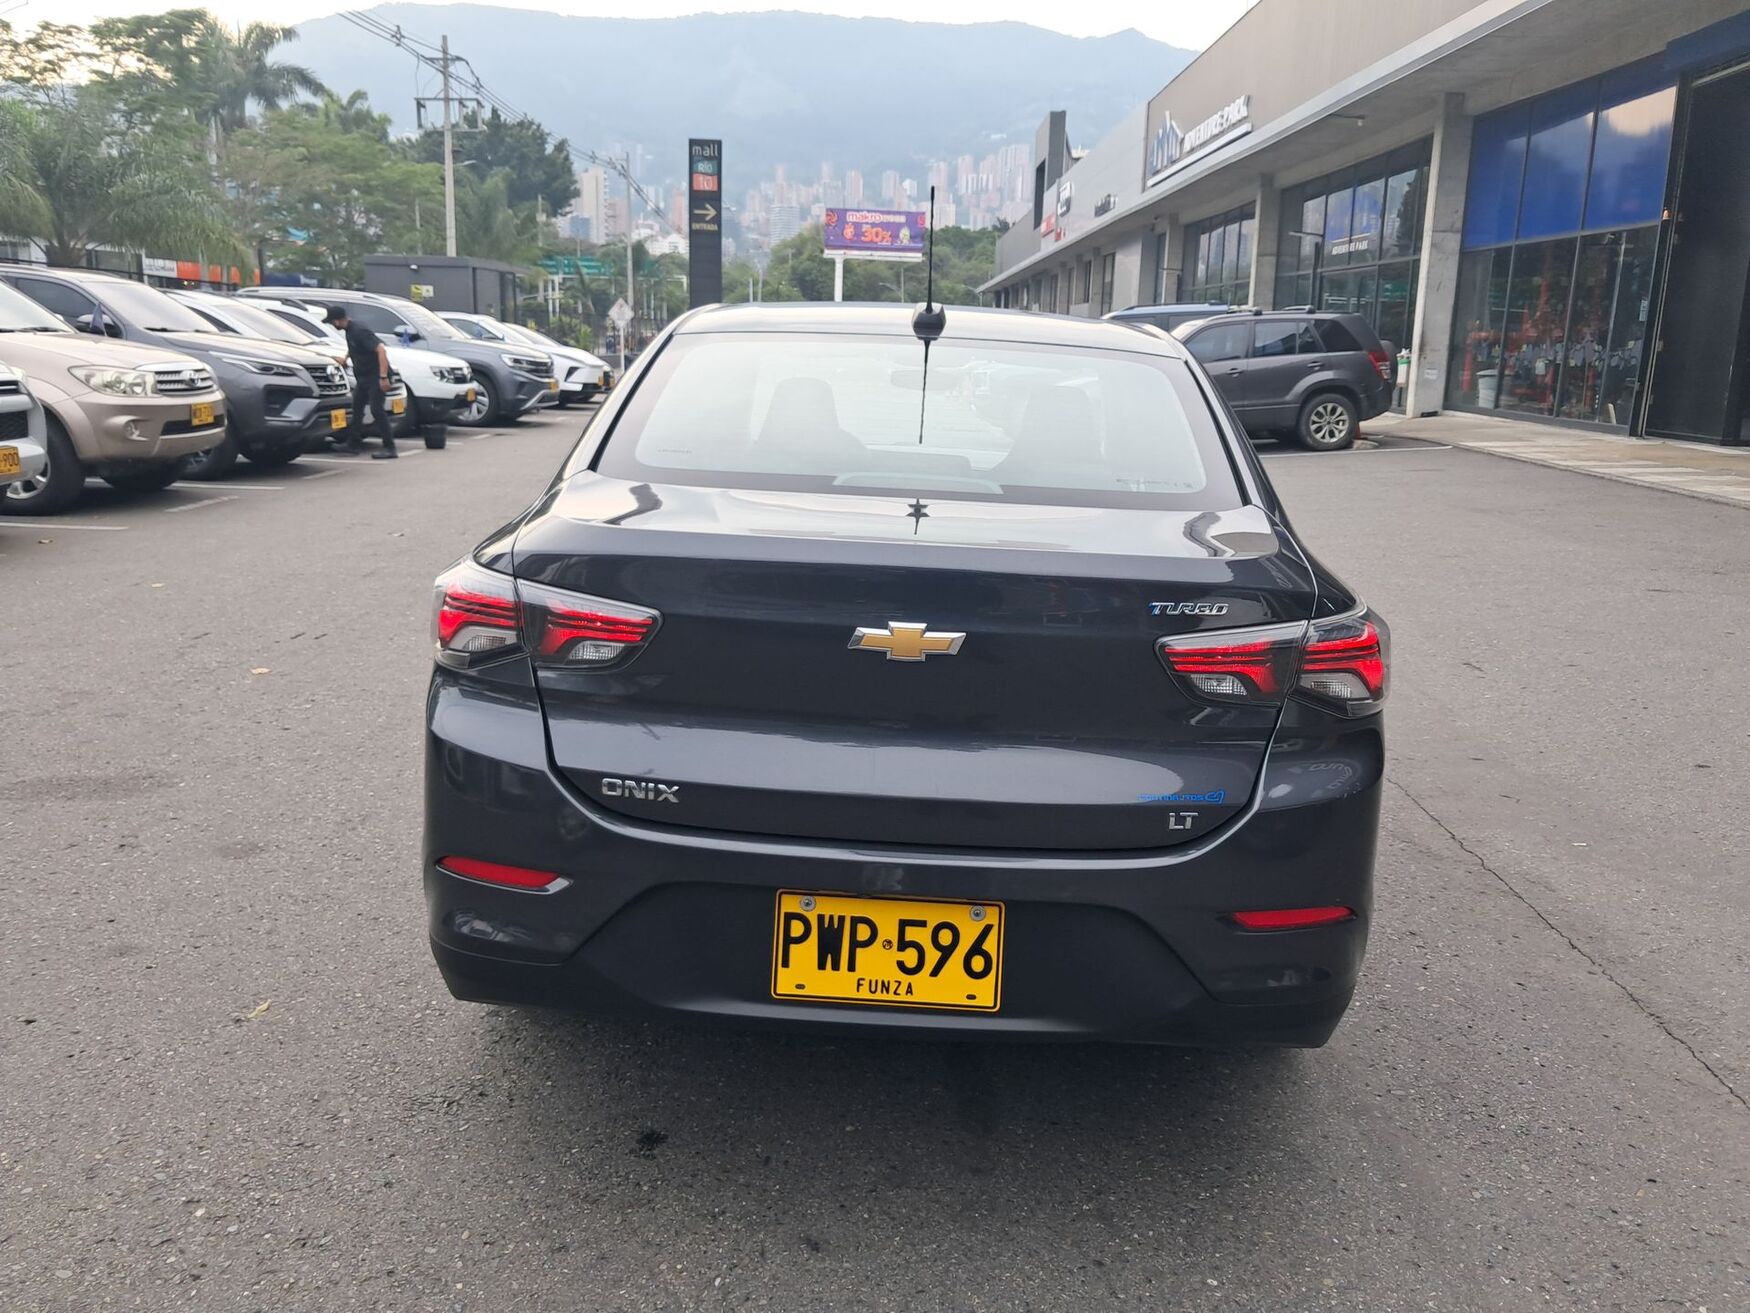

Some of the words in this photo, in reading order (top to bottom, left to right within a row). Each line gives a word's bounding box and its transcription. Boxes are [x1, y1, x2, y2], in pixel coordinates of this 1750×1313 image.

[692, 143, 719, 157] mall
[691, 222, 719, 231] ENTRADA
[1149, 602, 1229, 615] TURBO
[601, 778, 680, 803] ONIX
[1168, 812, 1199, 830] LT
[856, 978, 914, 996] FUNZA
